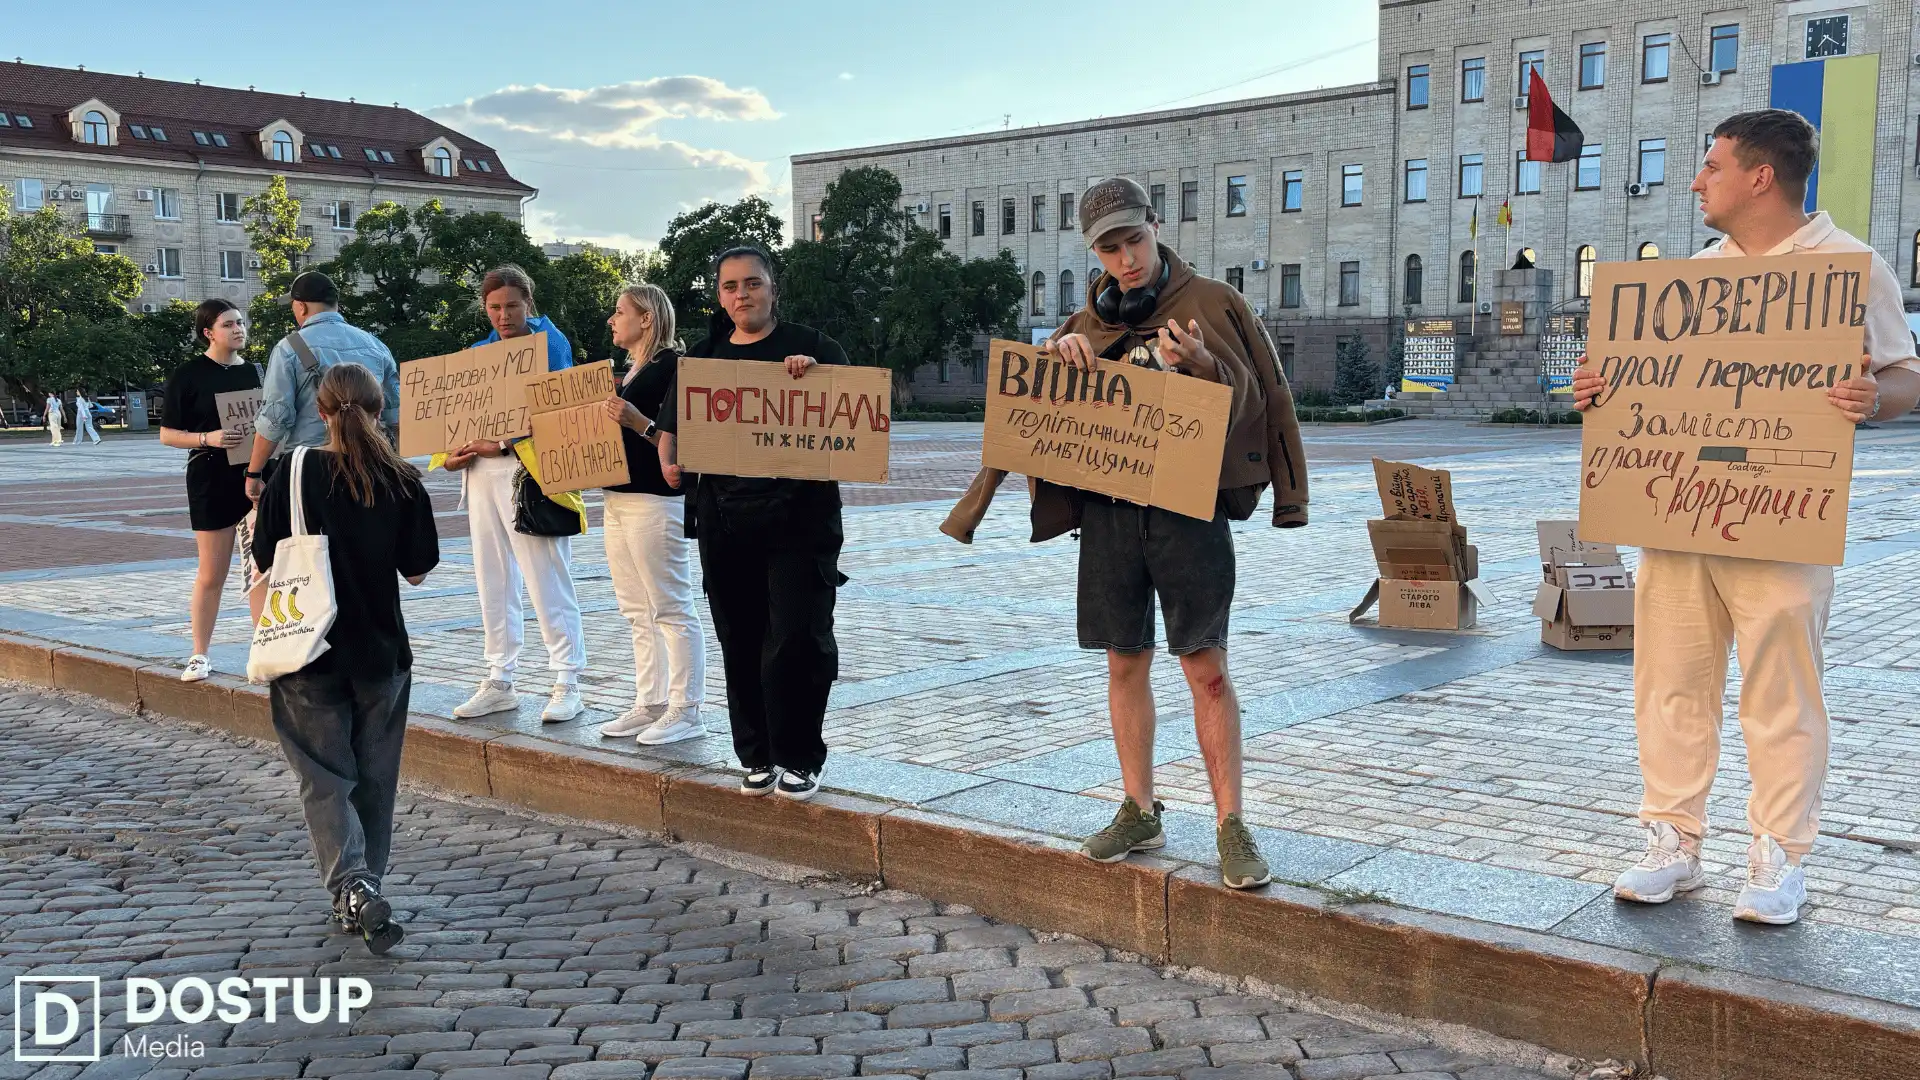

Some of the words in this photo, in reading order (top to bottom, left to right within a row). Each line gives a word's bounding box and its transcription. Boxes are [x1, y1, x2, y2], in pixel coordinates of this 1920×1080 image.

[1608, 264, 1866, 343] ПОВЕРНІТЬ
[503, 348, 534, 378] МО
[999, 350, 1132, 405] ВІЙНА
[415, 386, 493, 420] ВЕТЕРАНА
[527, 373, 567, 407] ТОБІ
[570, 366, 614, 401] ЛИЧИТЬ
[1697, 358, 1852, 409] перемоги
[447, 420, 461, 444] У
[558, 404, 605, 445] ЧУТИ
[1133, 403, 1203, 440] ПОЗА
[796, 434, 815, 450] НЕ
[820, 436, 856, 451] ЛОХ
[541, 440, 580, 485] СВІЙ
[581, 440, 623, 476] НАРОД
[1400, 593, 1440, 602] СТАРОГО
